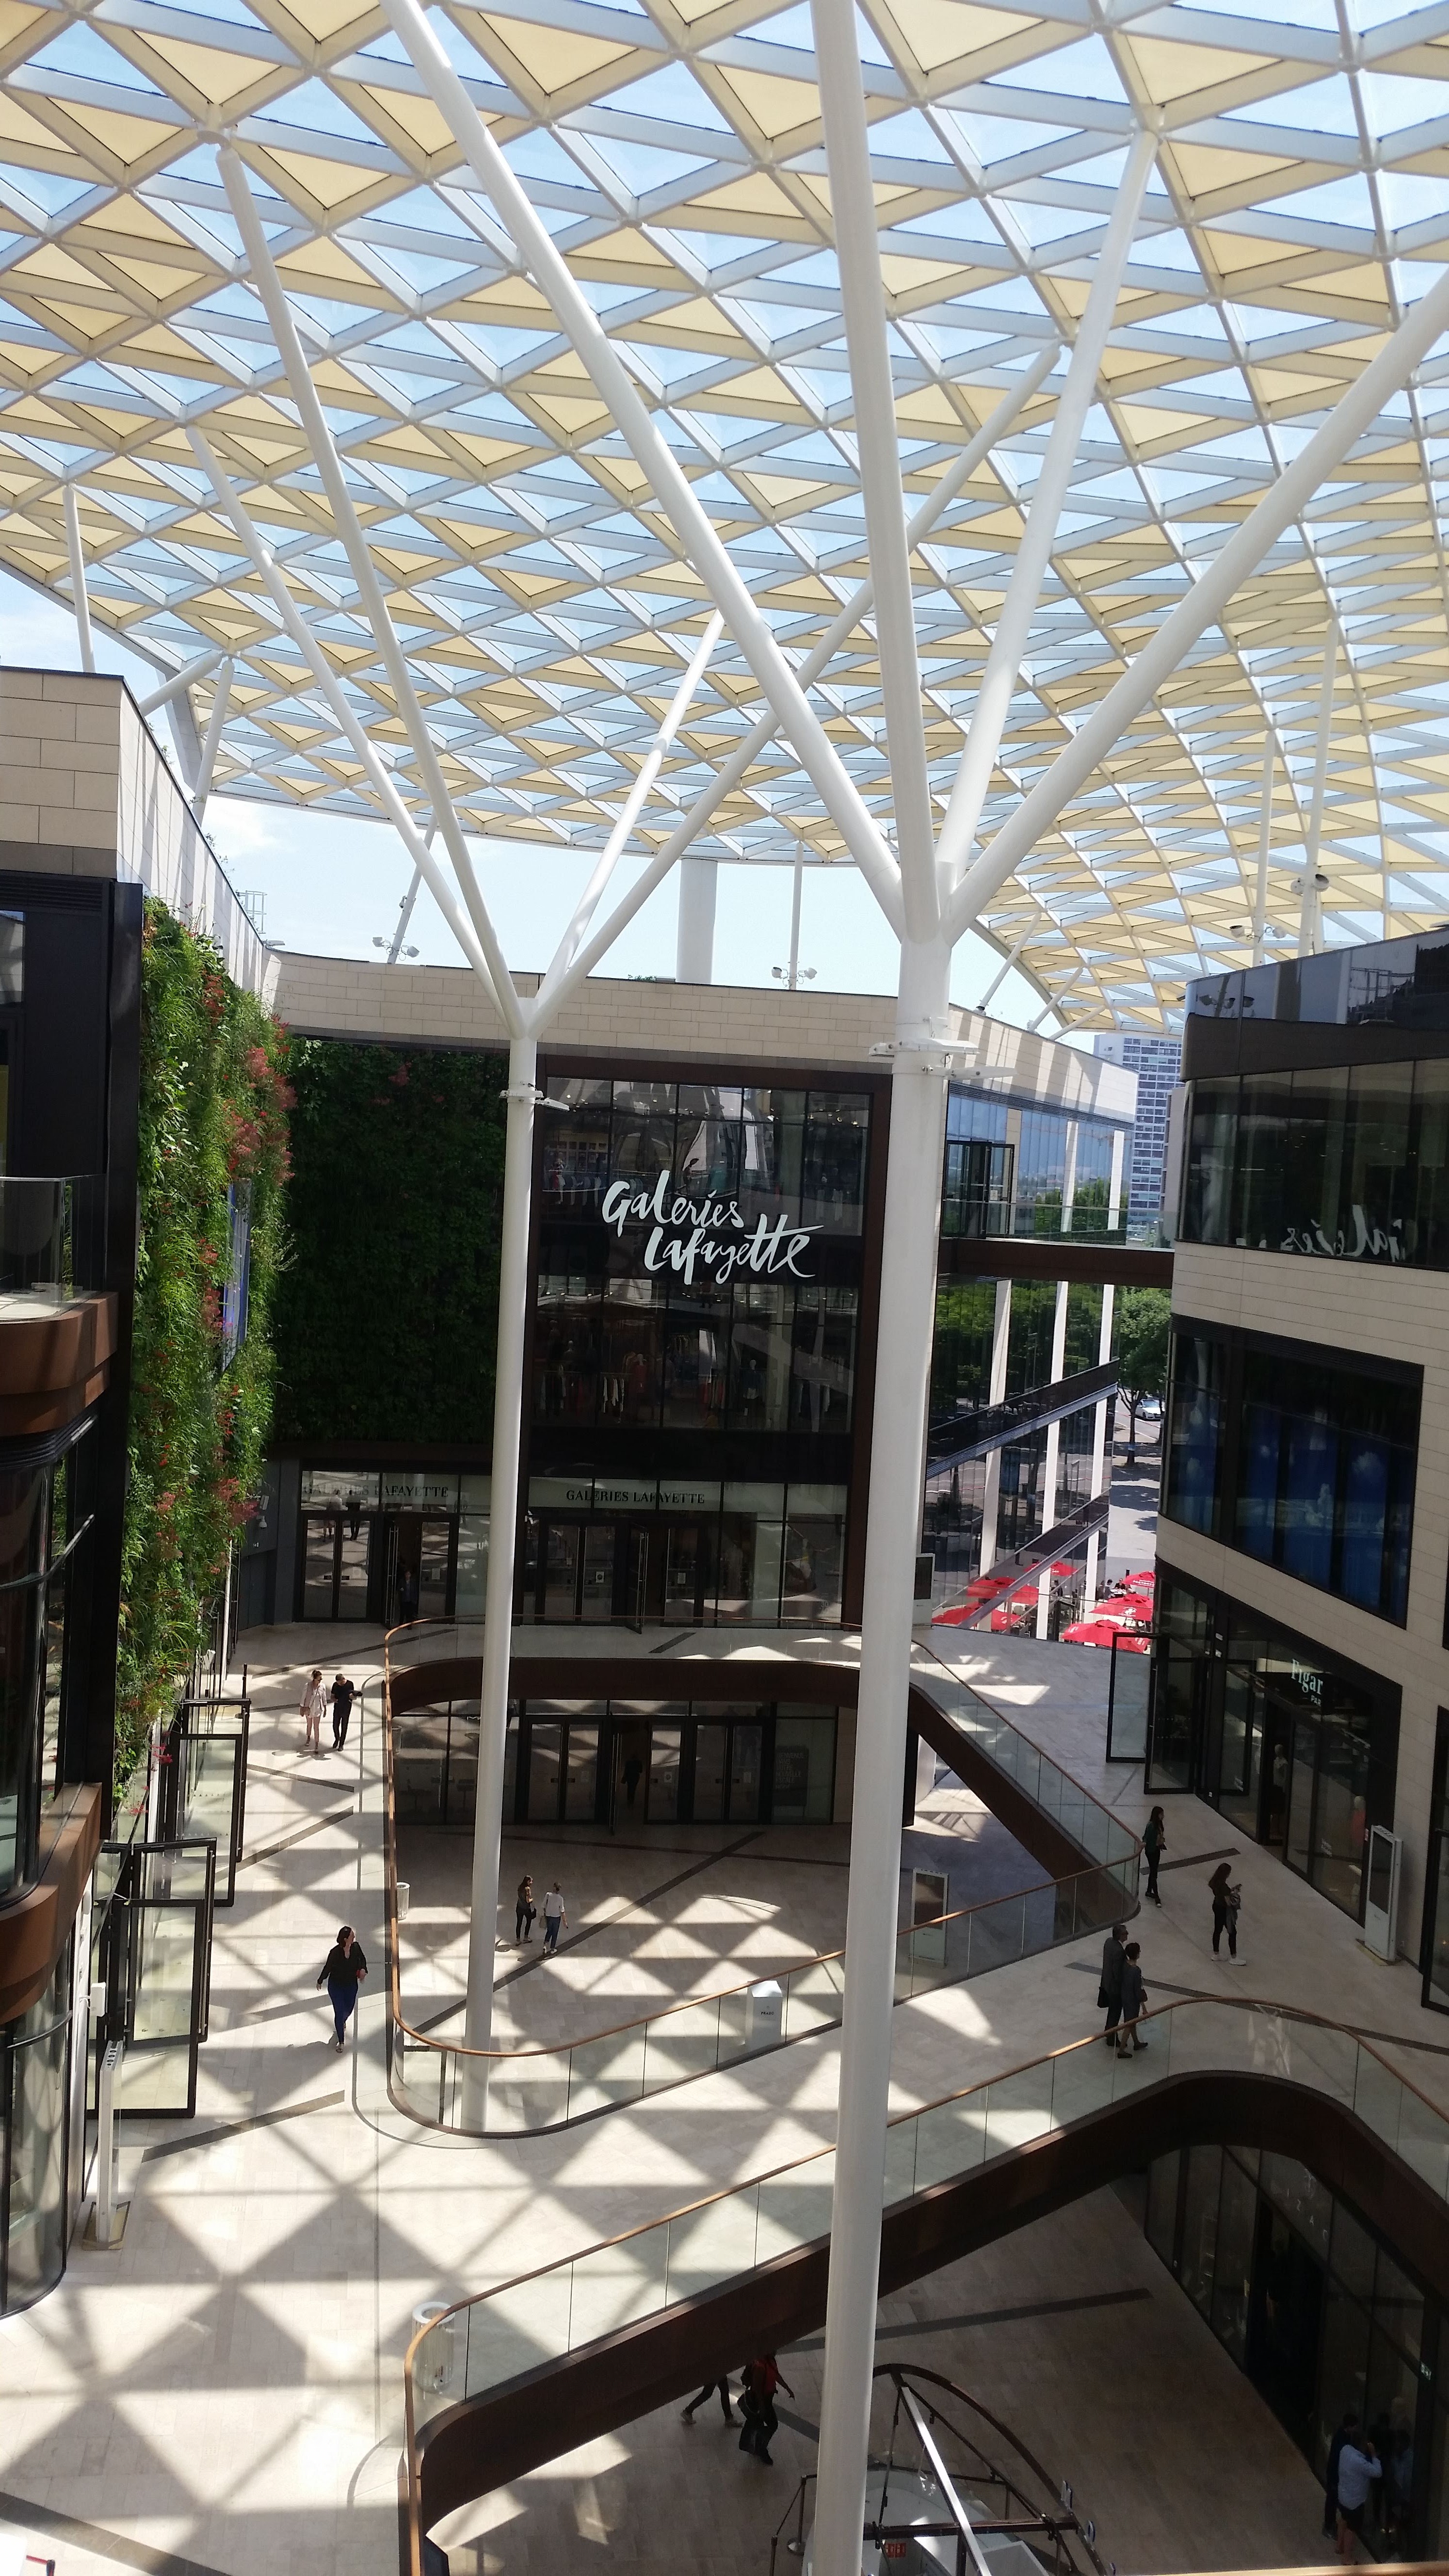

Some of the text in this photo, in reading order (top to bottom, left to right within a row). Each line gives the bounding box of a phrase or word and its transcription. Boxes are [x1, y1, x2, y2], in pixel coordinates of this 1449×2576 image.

[603, 1170, 744, 1236] Galeries
[645, 1214, 824, 1285] Lafayette
[375, 1486, 448, 1497] LAFAYETTE
[566, 1490, 705, 1503] GALERIES LAFAYETTE
